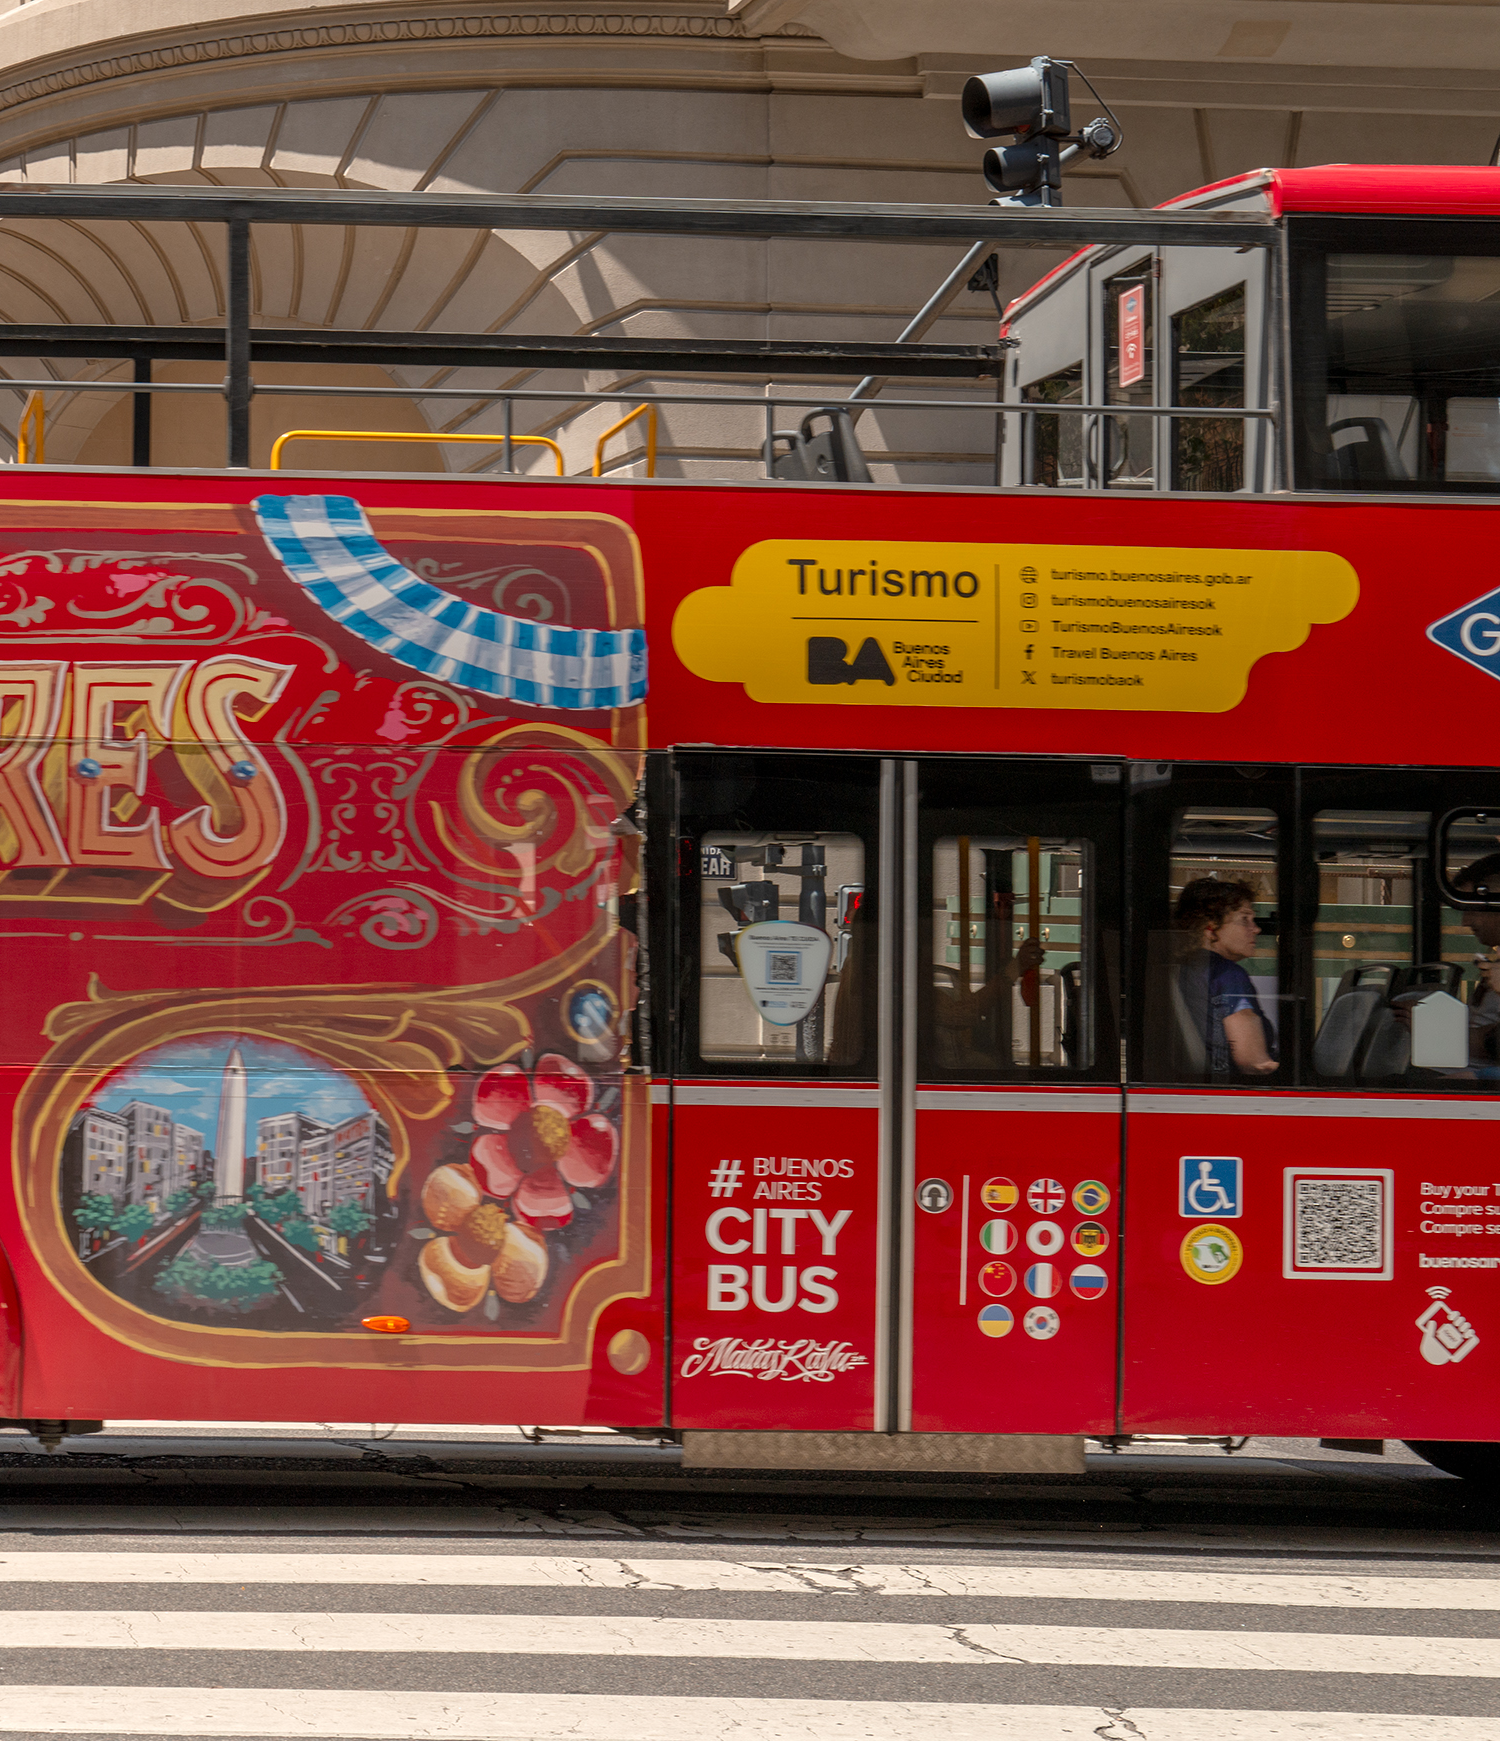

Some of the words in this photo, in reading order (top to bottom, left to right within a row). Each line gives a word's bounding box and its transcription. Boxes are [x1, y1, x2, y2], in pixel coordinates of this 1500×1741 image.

[787, 559, 979, 598] Turismo
[1051, 569, 1253, 587] turismo.buenosaires.gob.ar
[1051, 595, 1216, 610] turismobuenosairesok
[1051, 620, 1223, 636] TurismoBuenosAiresok
[1460, 612, 1500, 656] G
[893, 641, 950, 655] Buenos
[1051, 646, 1097, 660] Travel
[1100, 647, 1155, 661] Buenos
[1158, 649, 1198, 662] Aires
[807, 636, 896, 686] BA
[902, 656, 945, 669] Aires
[907, 670, 963, 684] Ciudad
[1051, 673, 1144, 686] turismobaok
[753, 1157, 854, 1178] BUENOS
[753, 1181, 822, 1201] AIRES
[1420, 1182, 1453, 1198] Buy
[1453, 1185, 1490, 1199] your
[1420, 1201, 1484, 1218] Compre
[705, 1207, 853, 1256] CITY
[1420, 1220, 1484, 1237] Compre
[707, 1264, 839, 1313] BUS
